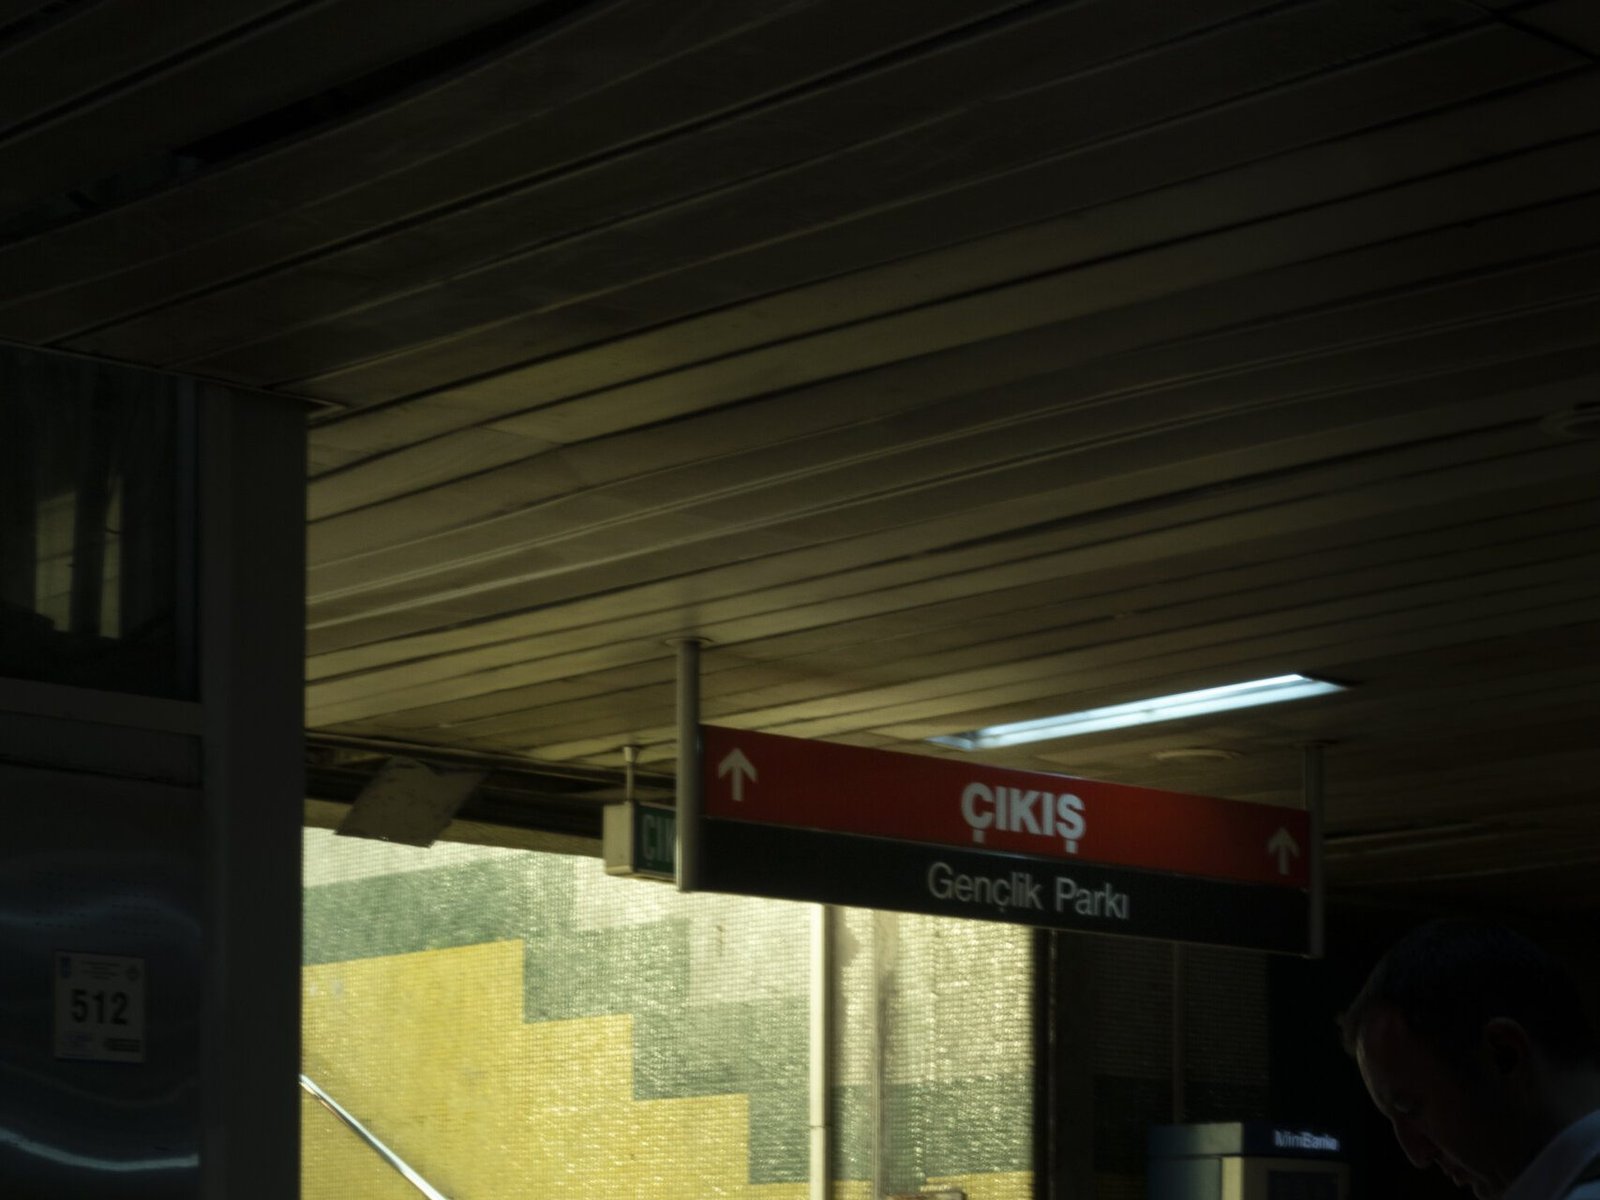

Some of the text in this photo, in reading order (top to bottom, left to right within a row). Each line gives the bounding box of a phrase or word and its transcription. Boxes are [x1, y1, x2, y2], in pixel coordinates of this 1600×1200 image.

[960, 781, 1087, 854] ÇIKIŞ
[927, 861, 1131, 920] Gençlik Parkı
[71, 988, 128, 1025] 512
